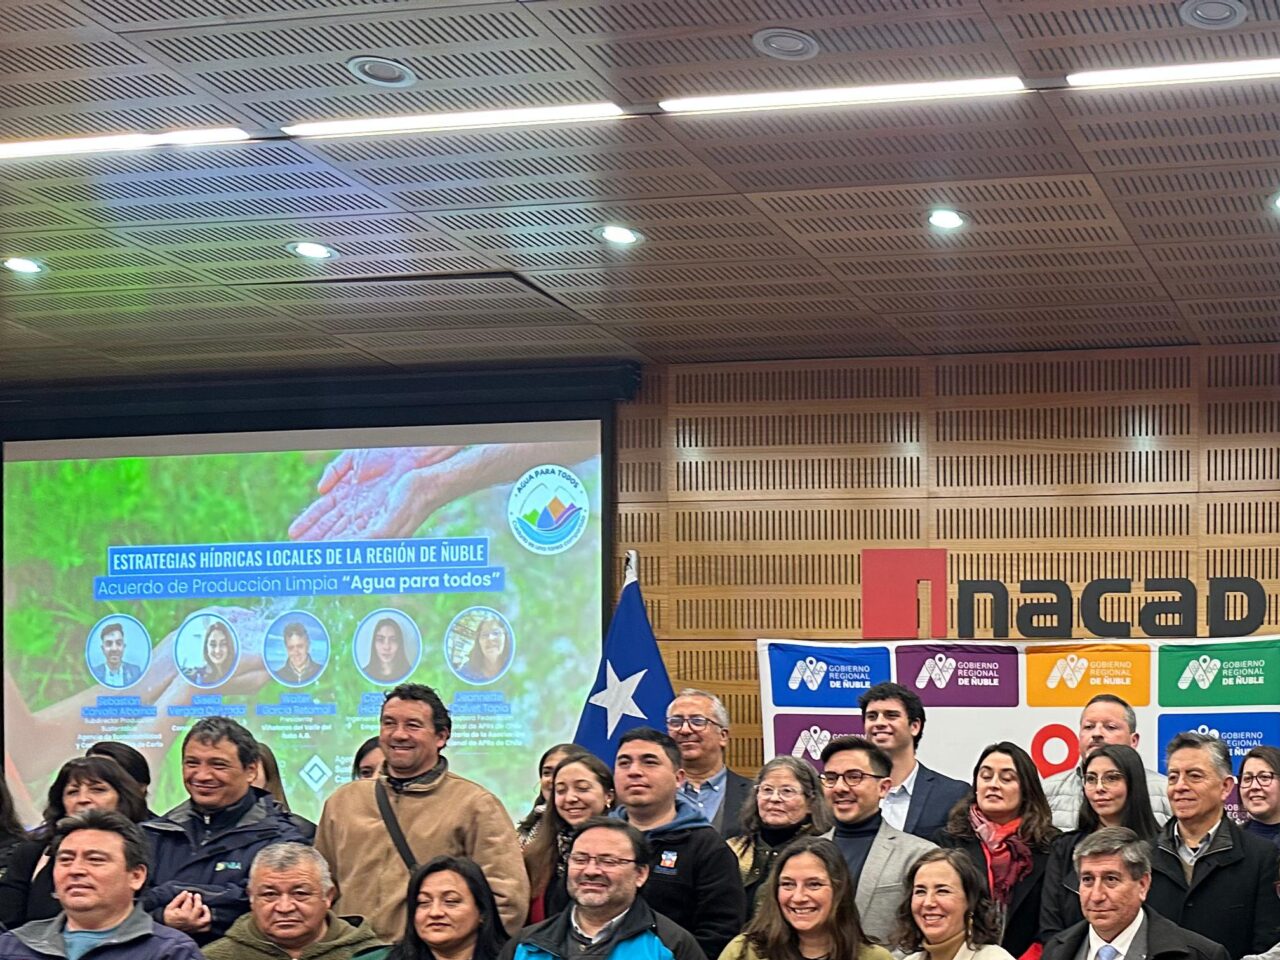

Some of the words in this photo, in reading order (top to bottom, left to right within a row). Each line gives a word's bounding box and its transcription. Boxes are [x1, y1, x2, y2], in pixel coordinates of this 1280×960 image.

[517, 475, 534, 493] AGUA
[534, 468, 556, 478] PARA
[558, 470, 579, 488] TODOS
[113, 553, 196, 570] ESTRATEGIAS
[200, 547, 262, 568] HÍDRICAS
[266, 548, 322, 566] LOCALES
[326, 548, 342, 564] DE
[346, 548, 362, 564] LA
[366, 542, 415, 563] REGIÓN
[420, 546, 437, 562] DE
[441, 541, 484, 562] ÑUBLE
[98, 579, 163, 595] Acuerdo
[168, 579, 188, 594] de
[193, 576, 281, 594] Producción
[286, 575, 338, 594] Limpia
[399, 576, 440, 593] para
[828, 665, 870, 673] GOBIERNO
[958, 661, 999, 670] GOBIERNO
[1222, 660, 1265, 668] GOBIERNO
[958, 669, 999, 677] REGIONAL
[1090, 668, 1132, 676] REGIONAL
[1222, 668, 1264, 676] REGIONAL
[829, 681, 841, 689] DE
[843, 679, 871, 689] ÑUBLE
[958, 677, 969, 686] DE
[971, 676, 999, 686] ÑUBLE
[1090, 677, 1101, 685] DE
[1104, 675, 1131, 685] ÑUBLE
[1222, 677, 1234, 685] DE
[1236, 675, 1264, 685] ÑUBLE
